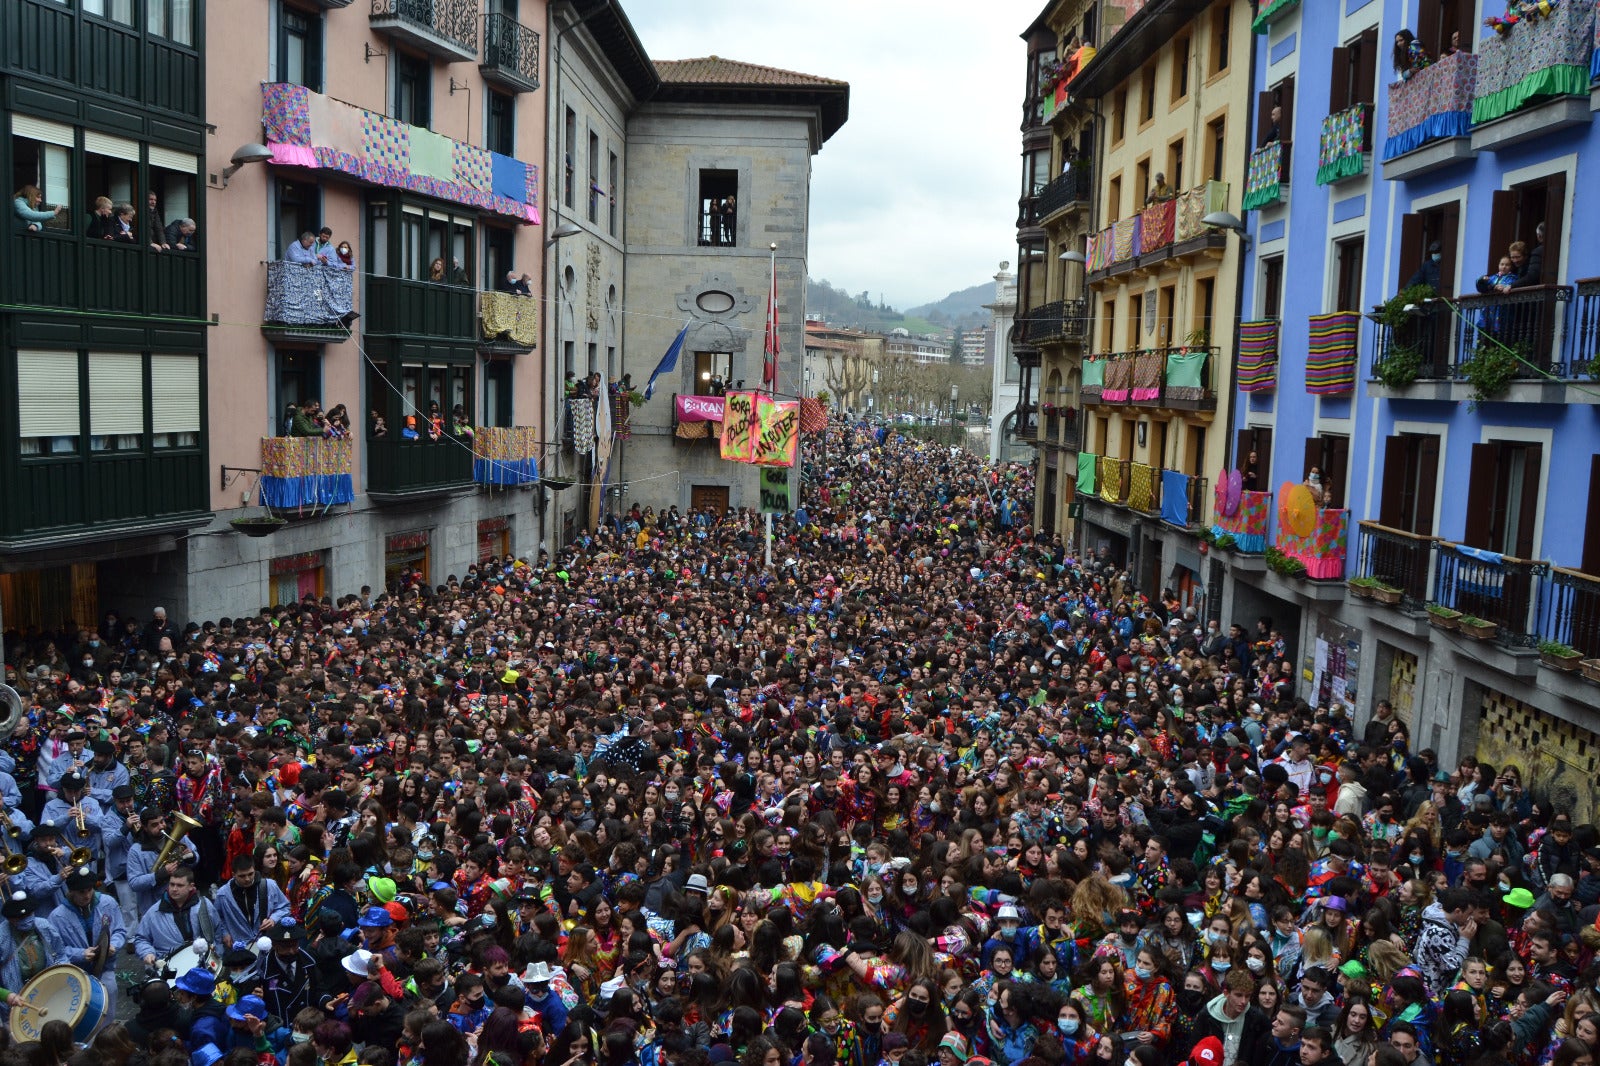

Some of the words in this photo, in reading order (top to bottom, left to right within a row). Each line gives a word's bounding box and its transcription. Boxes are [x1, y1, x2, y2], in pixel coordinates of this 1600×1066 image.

[730, 395, 750, 415] GORA
[760, 489, 788, 512] TOLOS
[21, 988, 39, 1015] AAI
